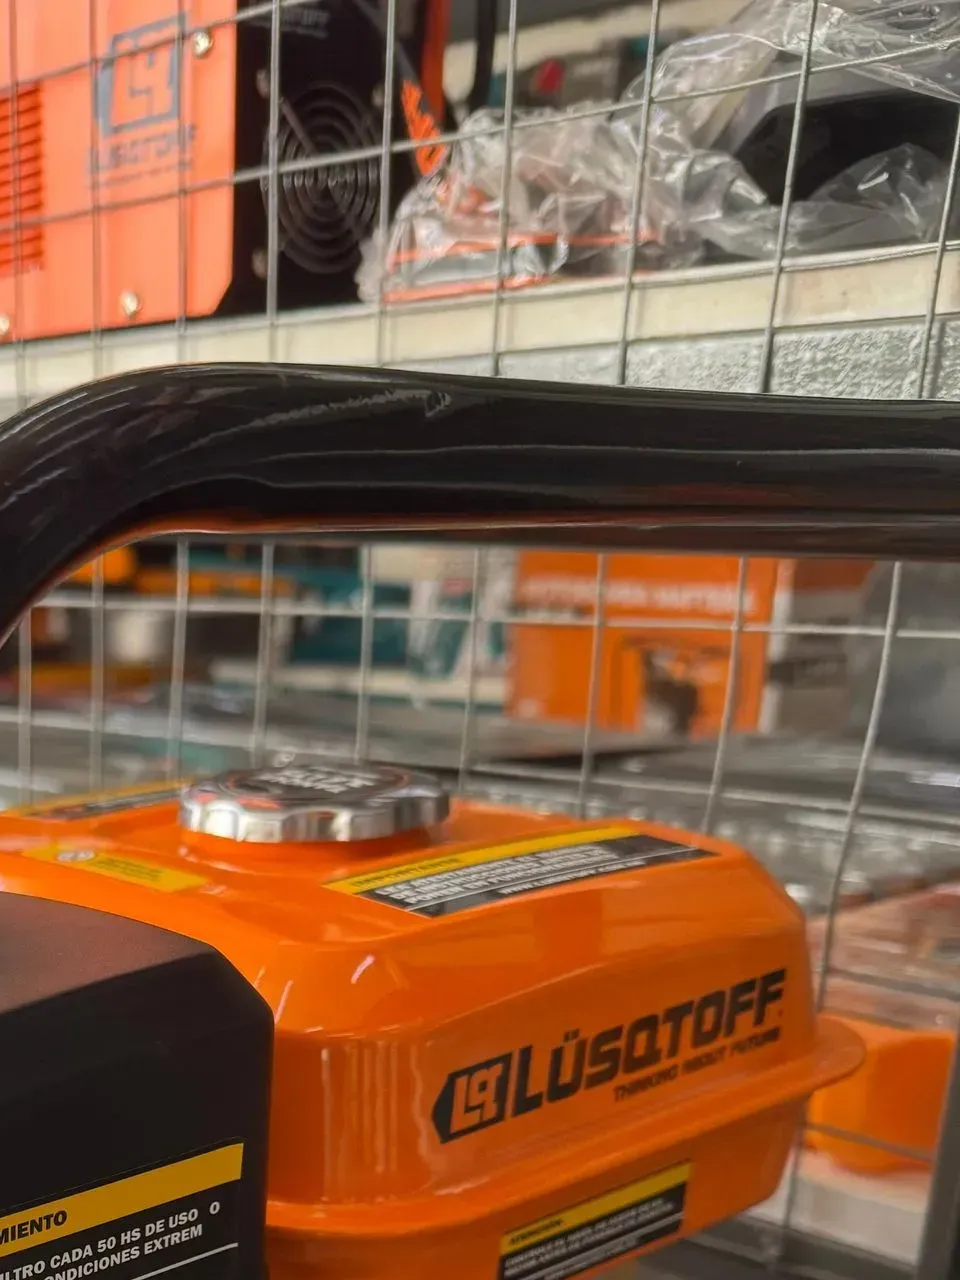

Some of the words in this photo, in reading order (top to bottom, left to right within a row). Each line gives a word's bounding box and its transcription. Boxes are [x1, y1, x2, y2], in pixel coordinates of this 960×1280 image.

[50, 1244, 93, 1269] CADA
[97, 1236, 117, 1253] 50
[120, 1227, 142, 1246] HS
[144, 1219, 166, 1238] DE
[168, 1208, 199, 1229] USO
[209, 1201, 221, 1216] O
[144, 1224, 203, 1256] EXTREM
